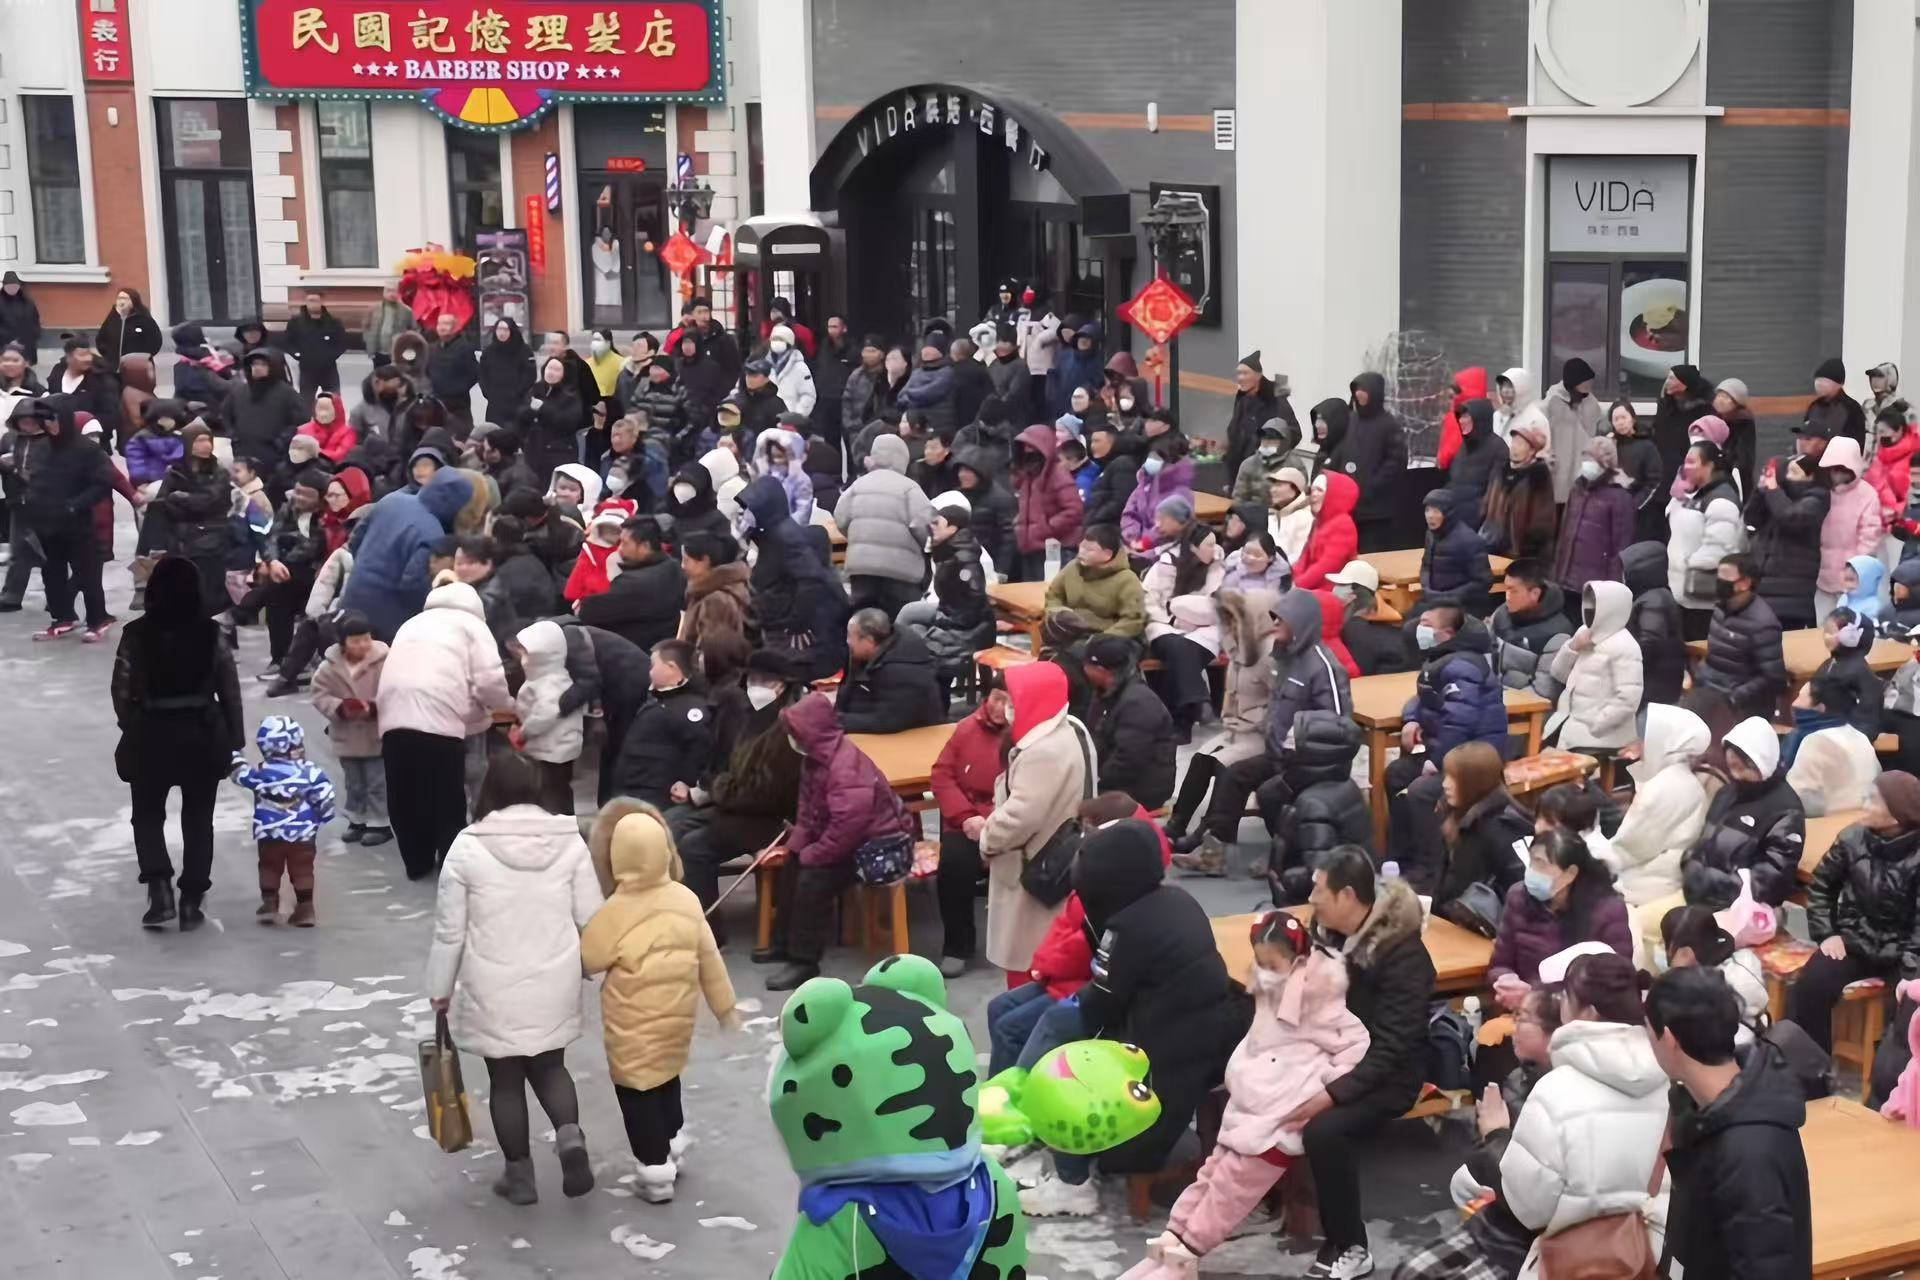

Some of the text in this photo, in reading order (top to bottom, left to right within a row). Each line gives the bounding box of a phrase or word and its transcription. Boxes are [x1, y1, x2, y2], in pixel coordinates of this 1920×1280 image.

[293, 7, 676, 57] 民國記憶理髮店
[404, 59, 570, 81] BARBER SHOP
[857, 106, 916, 157] VIDA
[1575, 181, 1654, 212] VIDA
